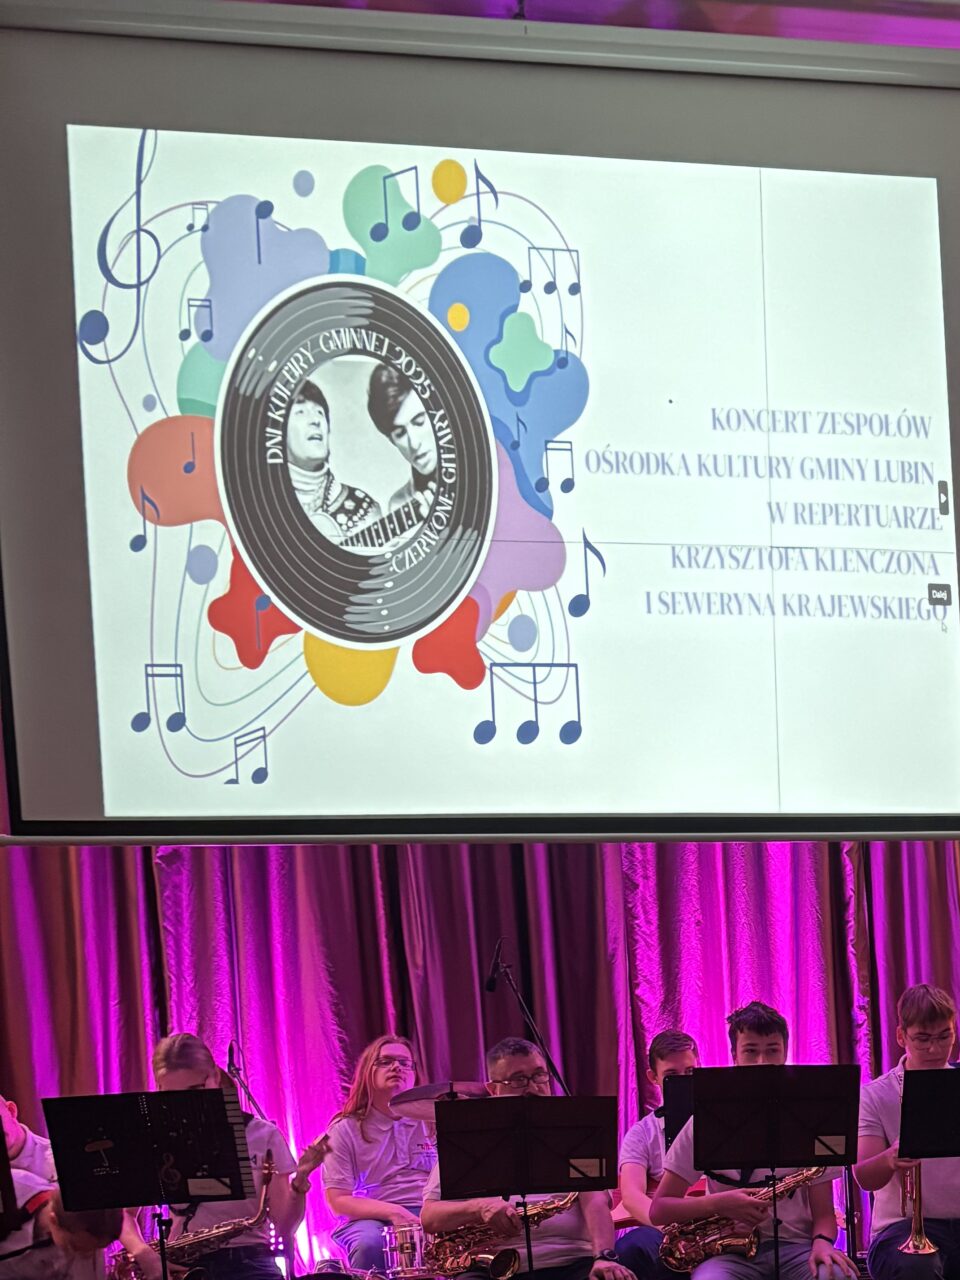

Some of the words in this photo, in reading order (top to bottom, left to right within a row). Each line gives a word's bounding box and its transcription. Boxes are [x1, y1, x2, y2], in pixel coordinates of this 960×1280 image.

[265, 427, 284, 464] DNI
[391, 346, 435, 399] 2025
[710, 407, 812, 434] KONCERT
[817, 408, 932, 439] ZESPOŁÓW
[428, 408, 457, 484] GITARY
[584, 443, 692, 477] OŚRODKA
[696, 453, 795, 479] KULTURY
[799, 456, 871, 482] GMINY
[874, 459, 935, 485] LUBIN
[767, 501, 787, 525] W
[793, 502, 944, 531] REPERTUARZE
[670, 545, 807, 571] KRZYSZTOFA
[814, 547, 940, 576] KLENCZONA
[645, 591, 652, 615] I
[658, 591, 776, 616] SEWERYNA
[783, 593, 947, 622] KRAJEWSKIEGO
